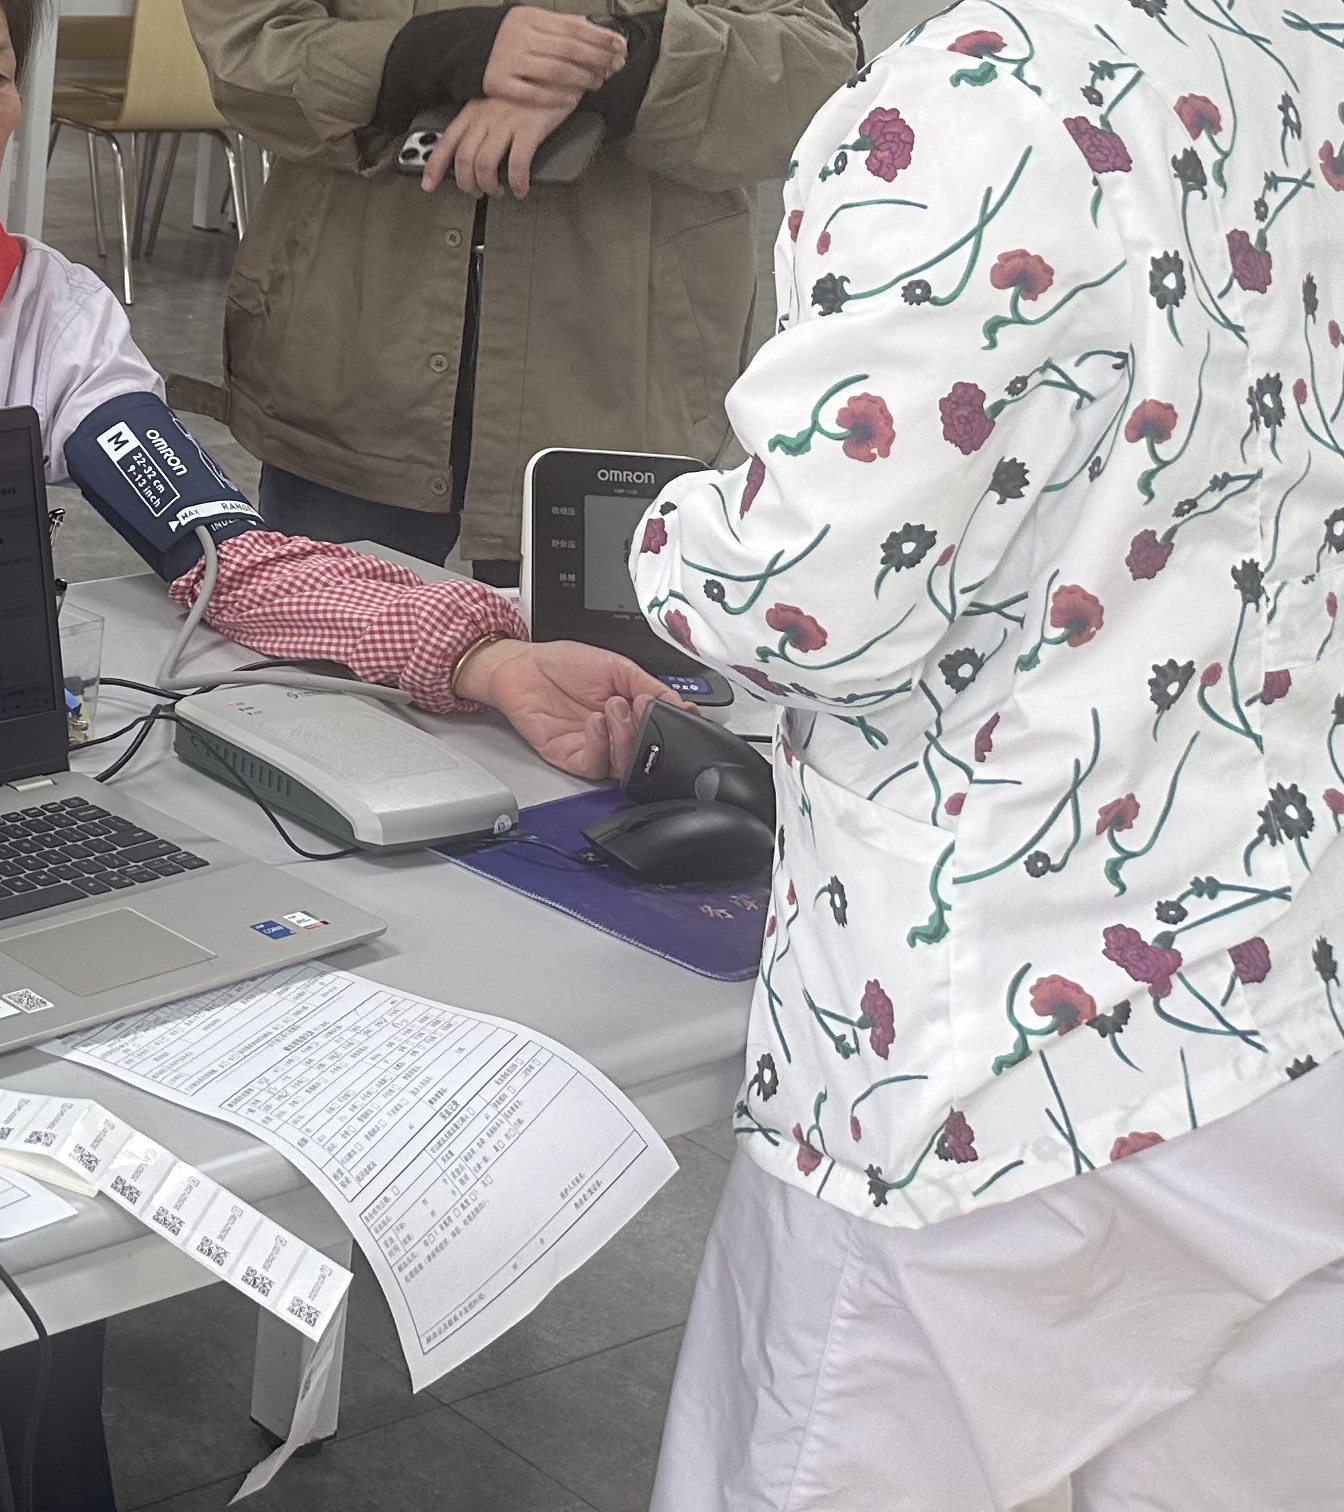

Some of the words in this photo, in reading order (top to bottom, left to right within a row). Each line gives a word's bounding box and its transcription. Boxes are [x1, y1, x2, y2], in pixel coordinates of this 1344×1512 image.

[107, 430, 130, 452] M
[145, 429, 188, 477] OMRON
[127, 464, 147, 488] 9-13
[142, 486, 162, 508] inch
[132, 452, 158, 479] 22-32
[153, 479, 165, 494] cm
[597, 469, 655, 485] OMRON
[180, 508, 201, 521] MAX
